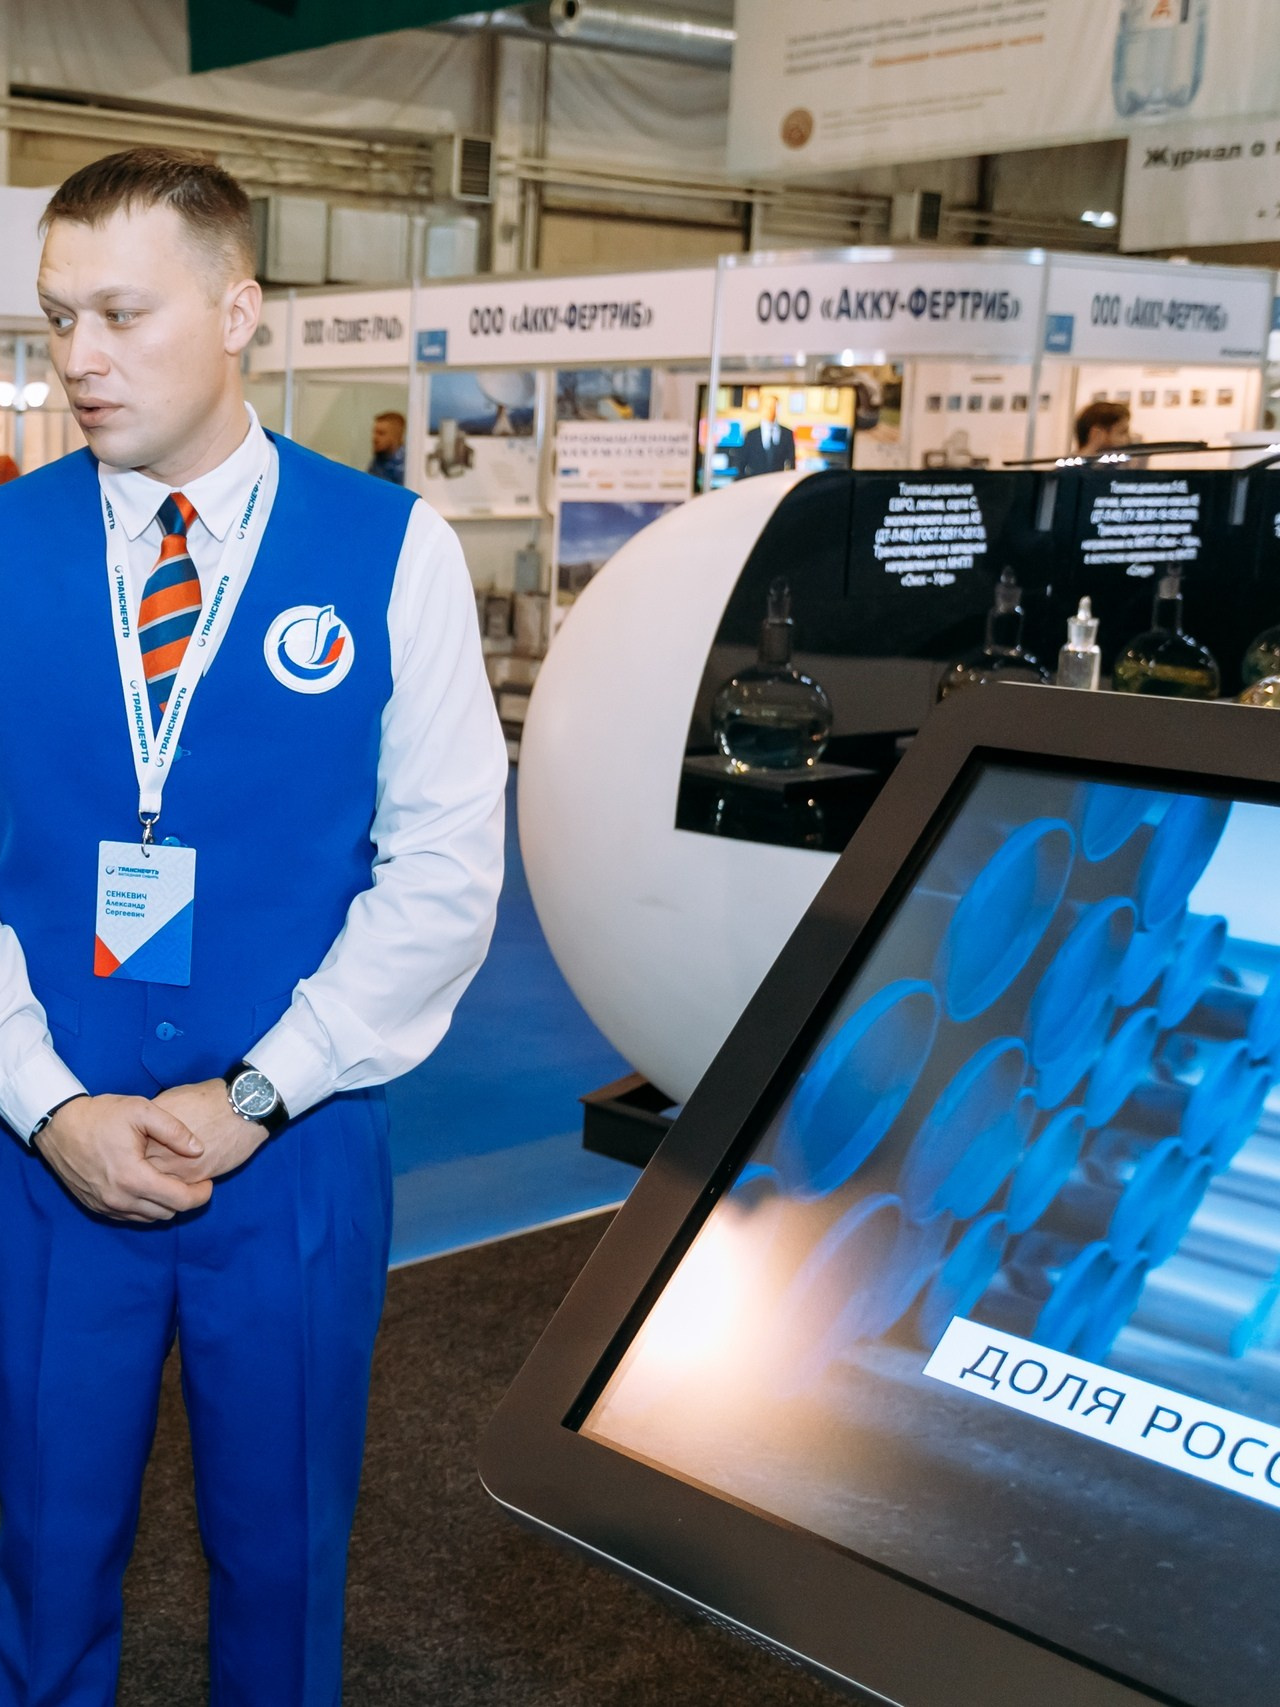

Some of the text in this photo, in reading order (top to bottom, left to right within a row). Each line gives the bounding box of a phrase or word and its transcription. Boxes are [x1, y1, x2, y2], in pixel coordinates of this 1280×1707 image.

[1143, 144, 1241, 171] Журнал
[1251, 140, 1266, 157] о
[470, 301, 654, 336] ООО «АККУ-ФЕРТРИБ»
[757, 286, 1021, 324] ООО «АККУ-ФЕРТРИБ»
[1090, 293, 1120, 326] ООО
[104, 494, 115, 530] НЕФТЬ
[116, 575, 130, 638] ТРАНСНЕФТЬ
[202, 574, 230, 636] ТРАНСНЕФТЬ
[132, 692, 149, 763] ТРАНСНЕФТЬ
[159, 687, 187, 755] ТРАНСНЕФТЬ
[105, 899, 145, 910] Александр
[105, 908, 145, 918] Сергеевич
[106, 890, 147, 900] СЕНКЕВИЧ
[959, 1345, 1126, 1426] ДОЛЯ
